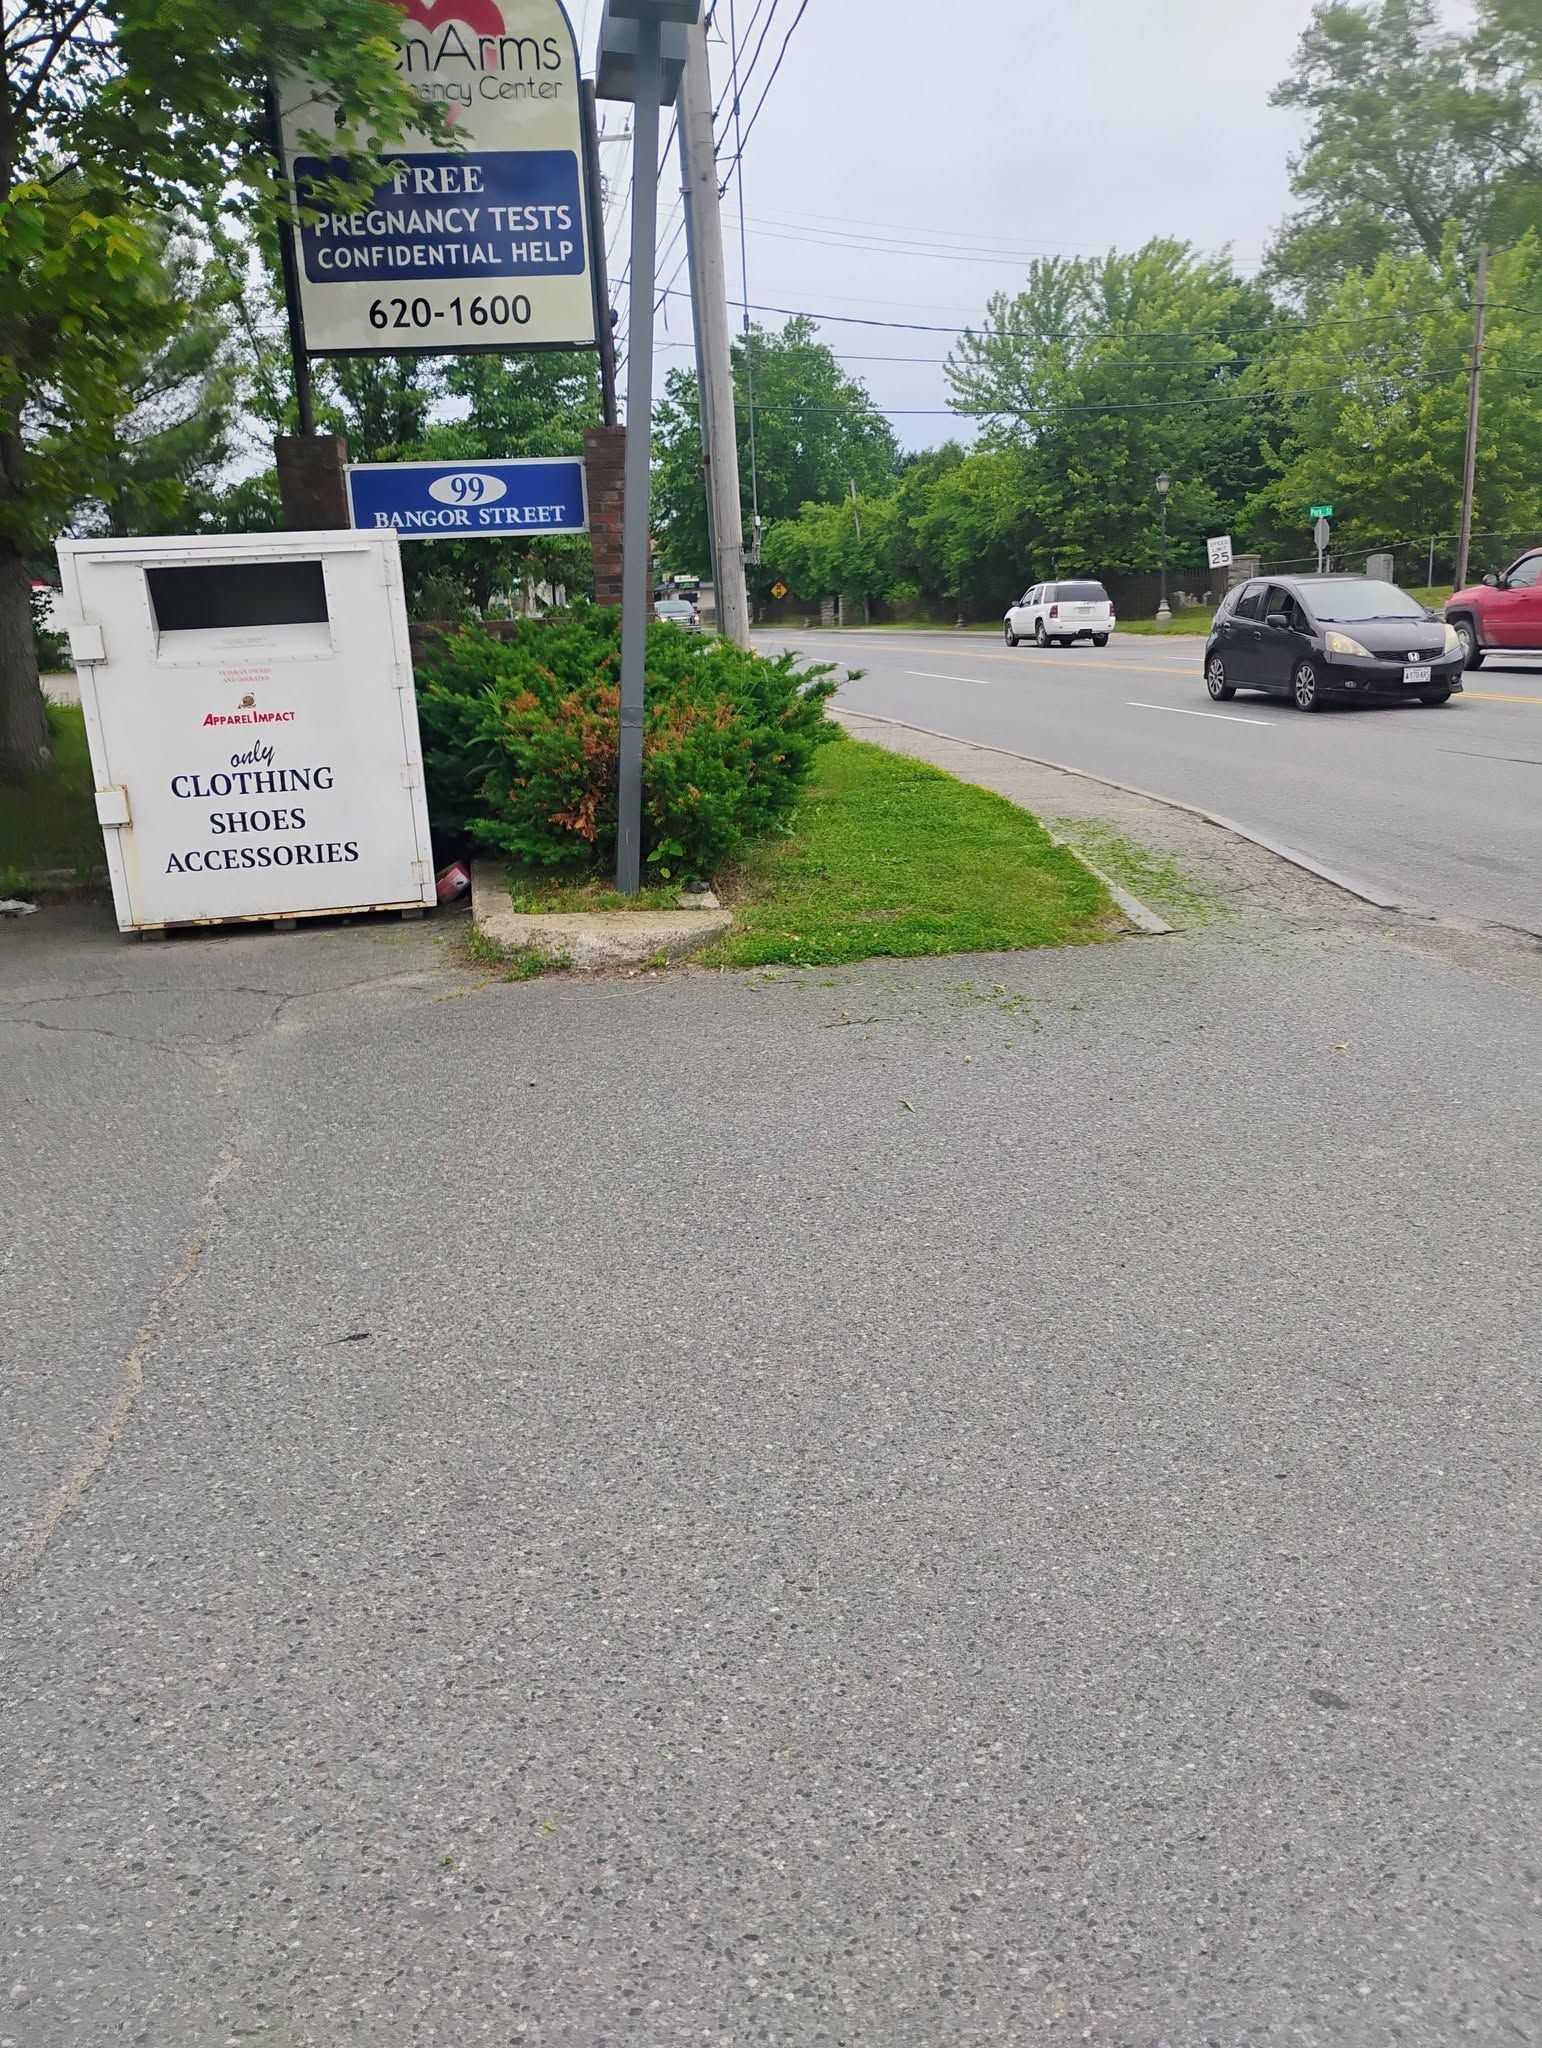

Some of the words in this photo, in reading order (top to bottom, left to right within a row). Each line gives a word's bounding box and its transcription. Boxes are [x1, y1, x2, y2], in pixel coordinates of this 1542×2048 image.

[479, 75, 563, 100] Center
[392, 165, 485, 195] FREE
[314, 207, 480, 237] PREGNANCY
[488, 205, 572, 232] TESTS
[317, 242, 502, 269] CONFIDENTIAL
[511, 240, 574, 263] HELP
[369, 294, 532, 330] 620-1600
[450, 476, 485, 503] 99
[374, 508, 472, 529] BANGOR
[479, 505, 566, 526] STREET
[1210, 539, 1228, 547] SPEED
[1211, 545, 1227, 553] LIMIT
[1211, 552, 1229, 564] 25
[230, 739, 275, 768] only
[170, 766, 334, 799] CLOTHING
[209, 807, 306, 835] SHOES
[165, 841, 360, 875] ACCESSORIES
